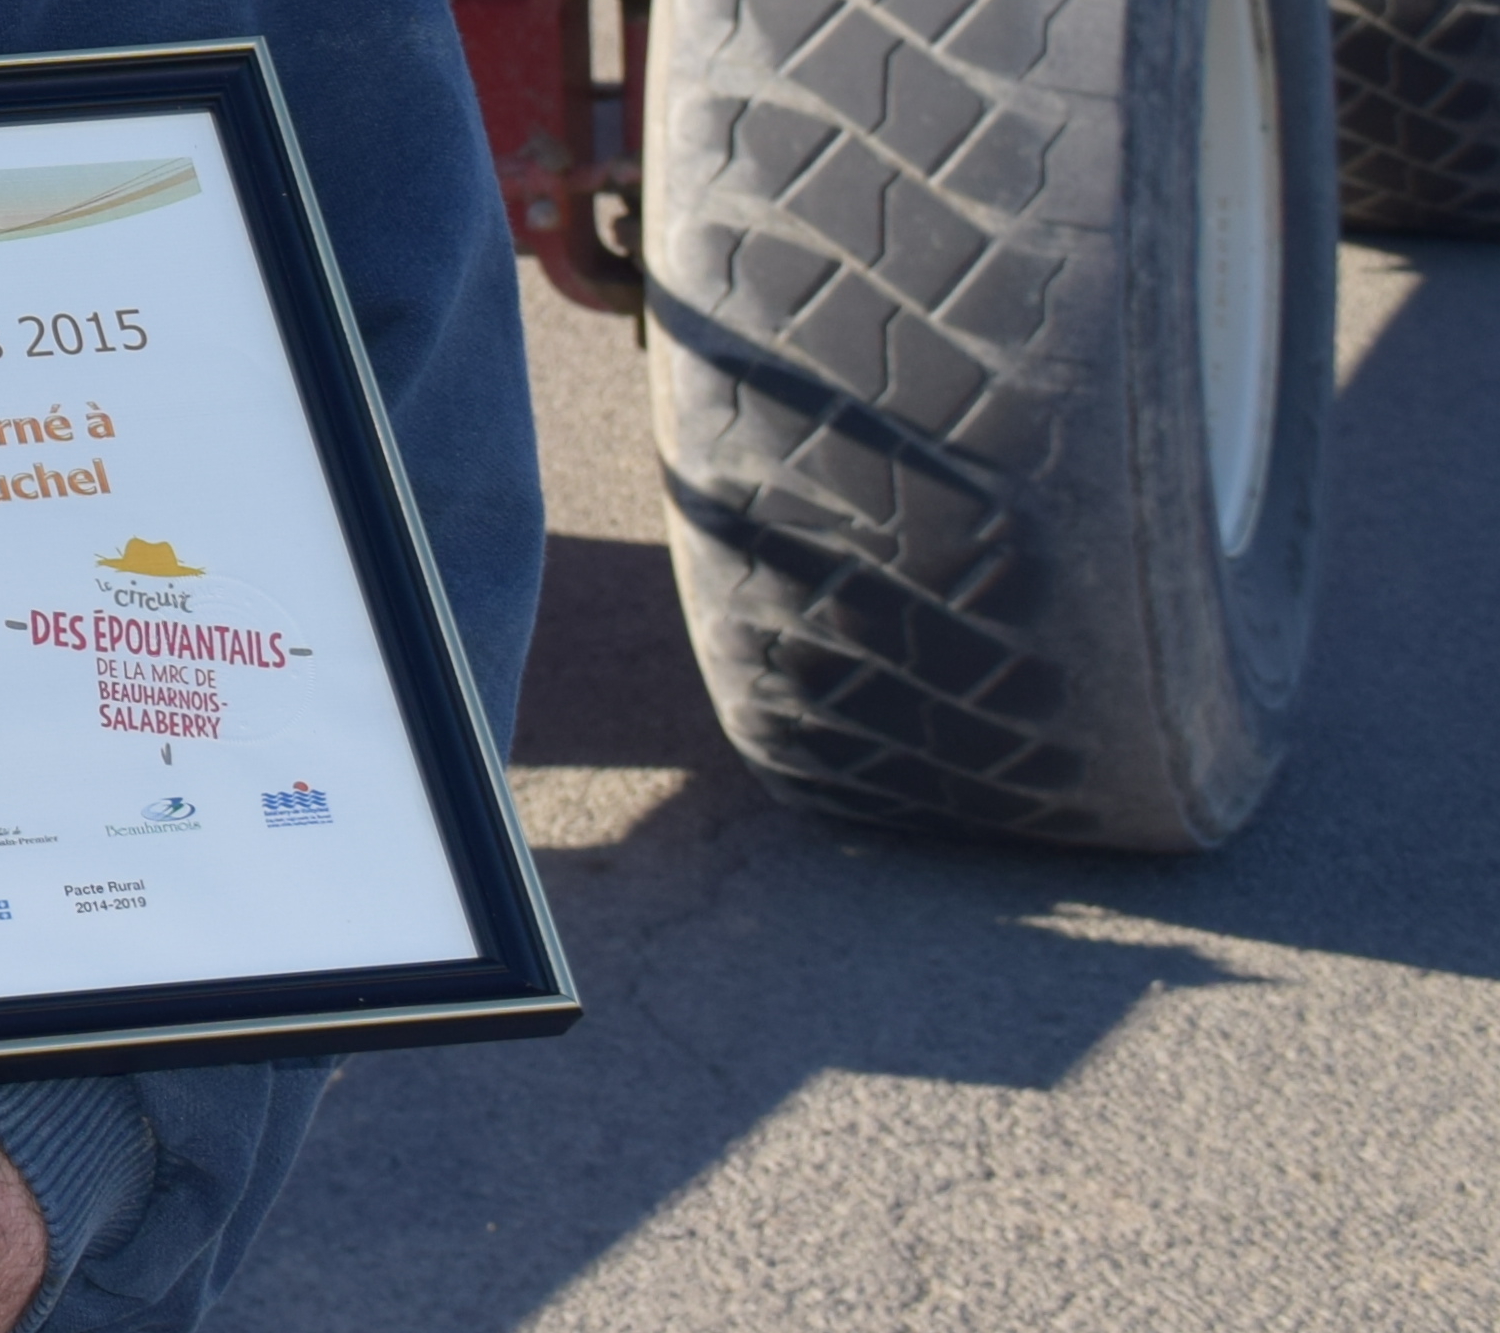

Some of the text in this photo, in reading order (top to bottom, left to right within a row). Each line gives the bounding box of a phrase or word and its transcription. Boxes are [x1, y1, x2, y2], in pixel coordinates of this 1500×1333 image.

[17, 308, 148, 358] 2015
[85, 400, 116, 440] à
[113, 580, 193, 614] circuit
[30, 609, 287, 669] DES ÉPOUVANTAILS
[96, 656, 217, 689] DE LA MRC DE
[98, 680, 229, 714] BEAUHARNOIS-
[99, 703, 222, 740] SALABERRY
[64, 879, 146, 897] Pacte Rural
[75, 896, 148, 914] 2014-2019
